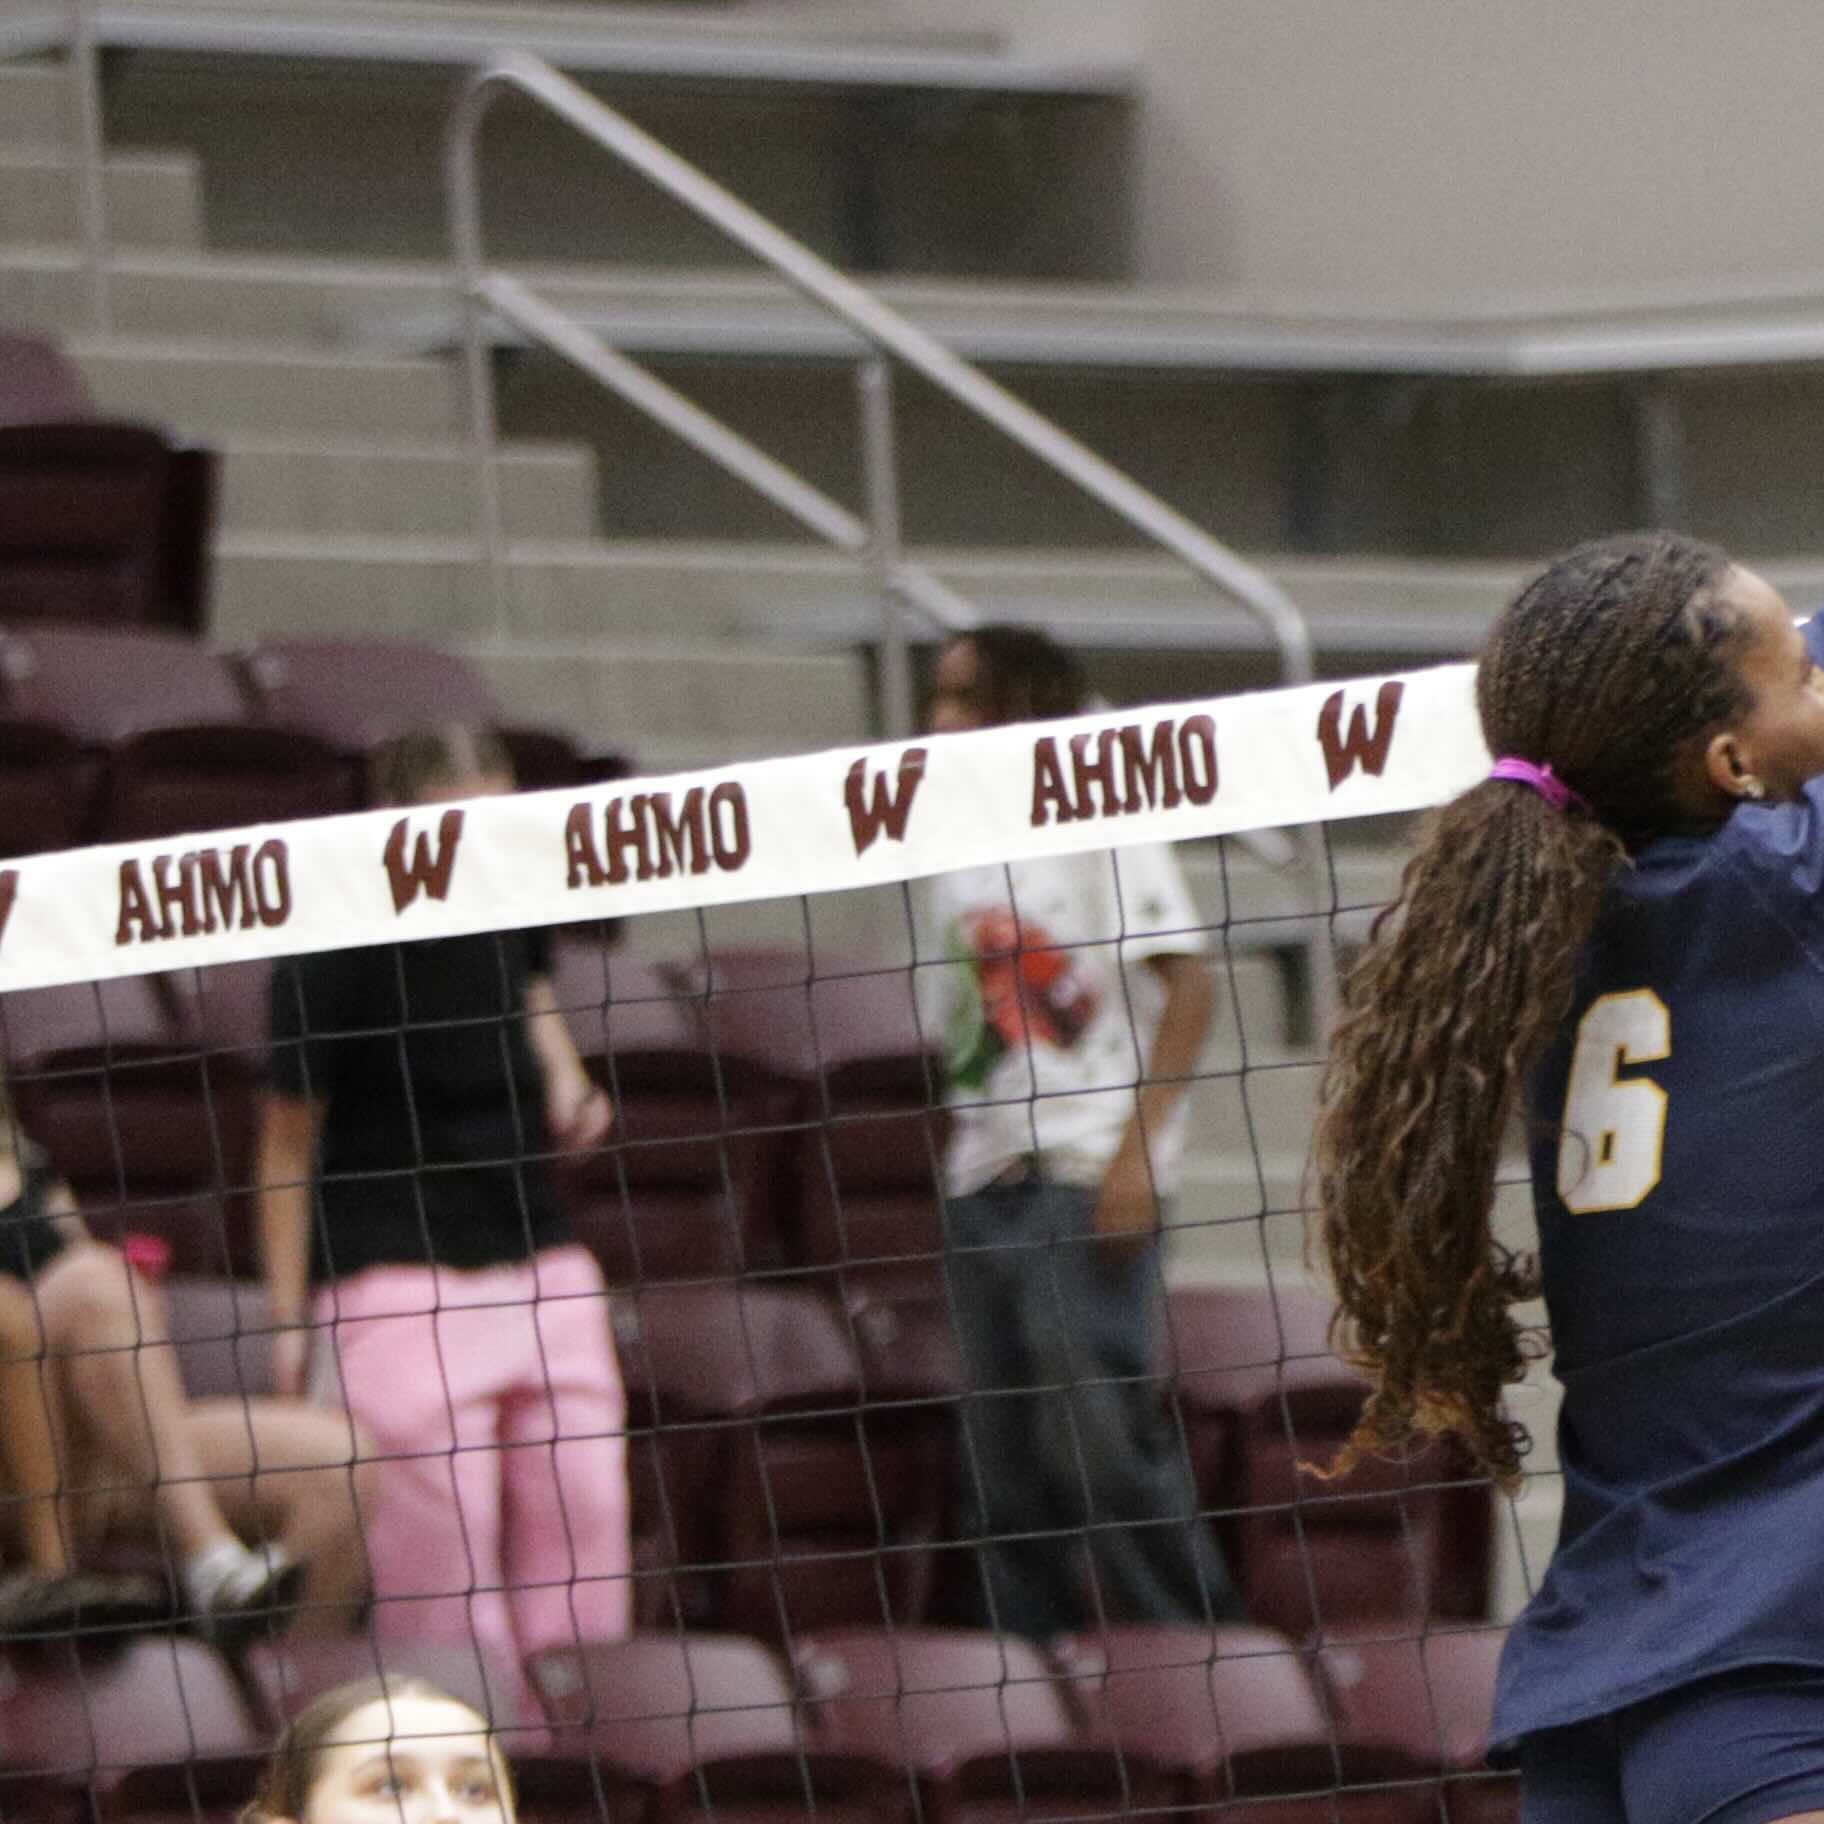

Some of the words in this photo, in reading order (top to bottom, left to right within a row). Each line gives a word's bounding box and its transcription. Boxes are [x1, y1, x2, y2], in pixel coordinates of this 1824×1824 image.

[113, 837, 293, 948] AHMO
[380, 807, 465, 917] W
[562, 780, 753, 891] AHMO
[842, 746, 929, 857] W
[1028, 713, 1220, 829] AHMO
[1314, 679, 1405, 793] W
[1556, 986, 1672, 1215] 6
